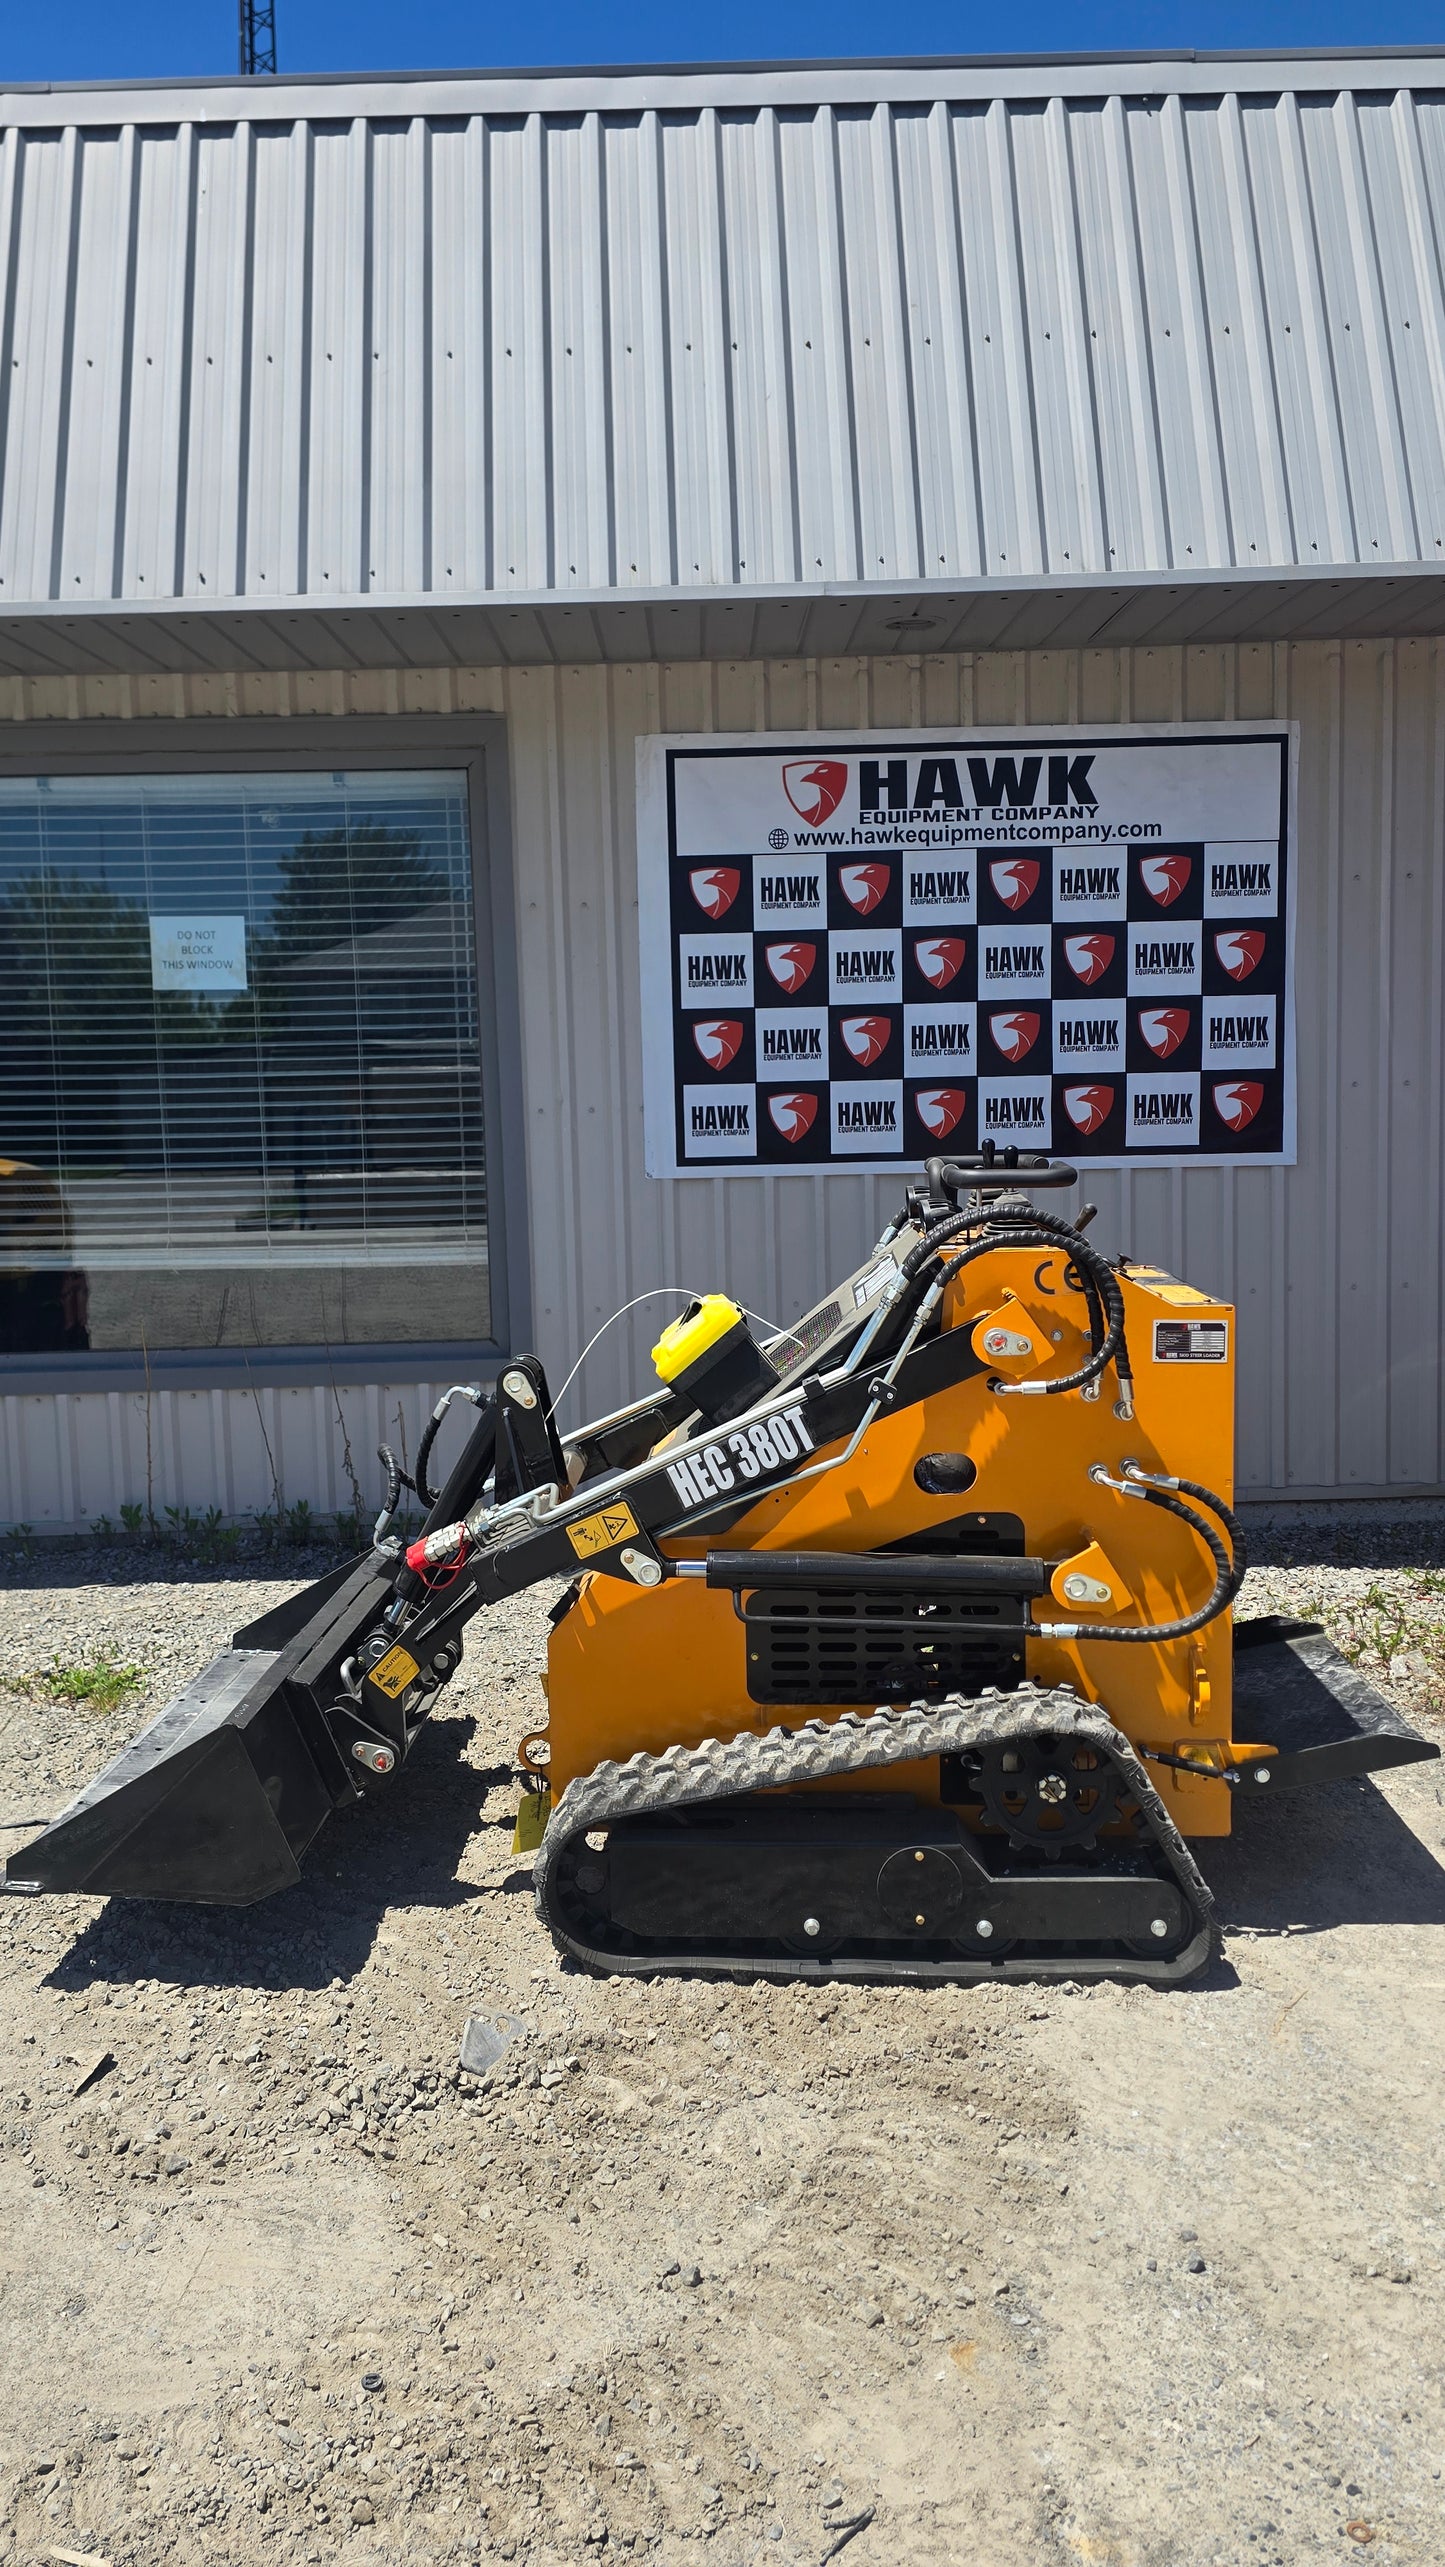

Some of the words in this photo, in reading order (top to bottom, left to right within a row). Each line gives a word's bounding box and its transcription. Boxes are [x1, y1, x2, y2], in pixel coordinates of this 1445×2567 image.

[859, 755, 1098, 810] HAWK
[859, 808, 984, 825] EQUIPMENT
[991, 805, 1100, 821] COMPANY
[794, 822, 1162, 848] www.hawkequipmentcompany.com
[761, 876, 820, 902] HAWK
[910, 872, 970, 898] HAWK
[1060, 868, 1120, 894] HAWK
[1212, 864, 1270, 890] HAWK
[761, 902, 791, 910] EQUIPMENT
[943, 896, 970, 904] COMPANY
[177, 931, 192, 940] DO
[195, 930, 216, 940] NOT
[181, 945, 214, 955] BLOCK
[986, 946, 1044, 972] HAWK
[1136, 942, 1194, 968] HAWK
[162, 960, 184, 969] THIS
[186, 959, 233, 969] WINDOW
[688, 955, 746, 980] HAWK
[836, 950, 895, 976] HAWK
[688, 980, 718, 988] EQUIPMENT
[836, 976, 867, 984] EQUIPMENT
[764, 1028, 821, 1054] HAWK
[912, 1024, 970, 1050] HAWK
[1060, 1020, 1118, 1046] HAWK
[1210, 1016, 1268, 1042] HAWK
[912, 1049, 942, 1057] EQUIPMENT
[692, 1105, 749, 1130] HAWK
[838, 1101, 896, 1126] HAWK
[986, 1097, 1044, 1122] HAWK
[1134, 1094, 1192, 1119] HAWK
[1134, 1118, 1164, 1126] EQUIPMENT
[666, 1445, 735, 1508] HEC
[728, 1405, 815, 1478] 380T
[382, 1650, 404, 1673] CAUTION
